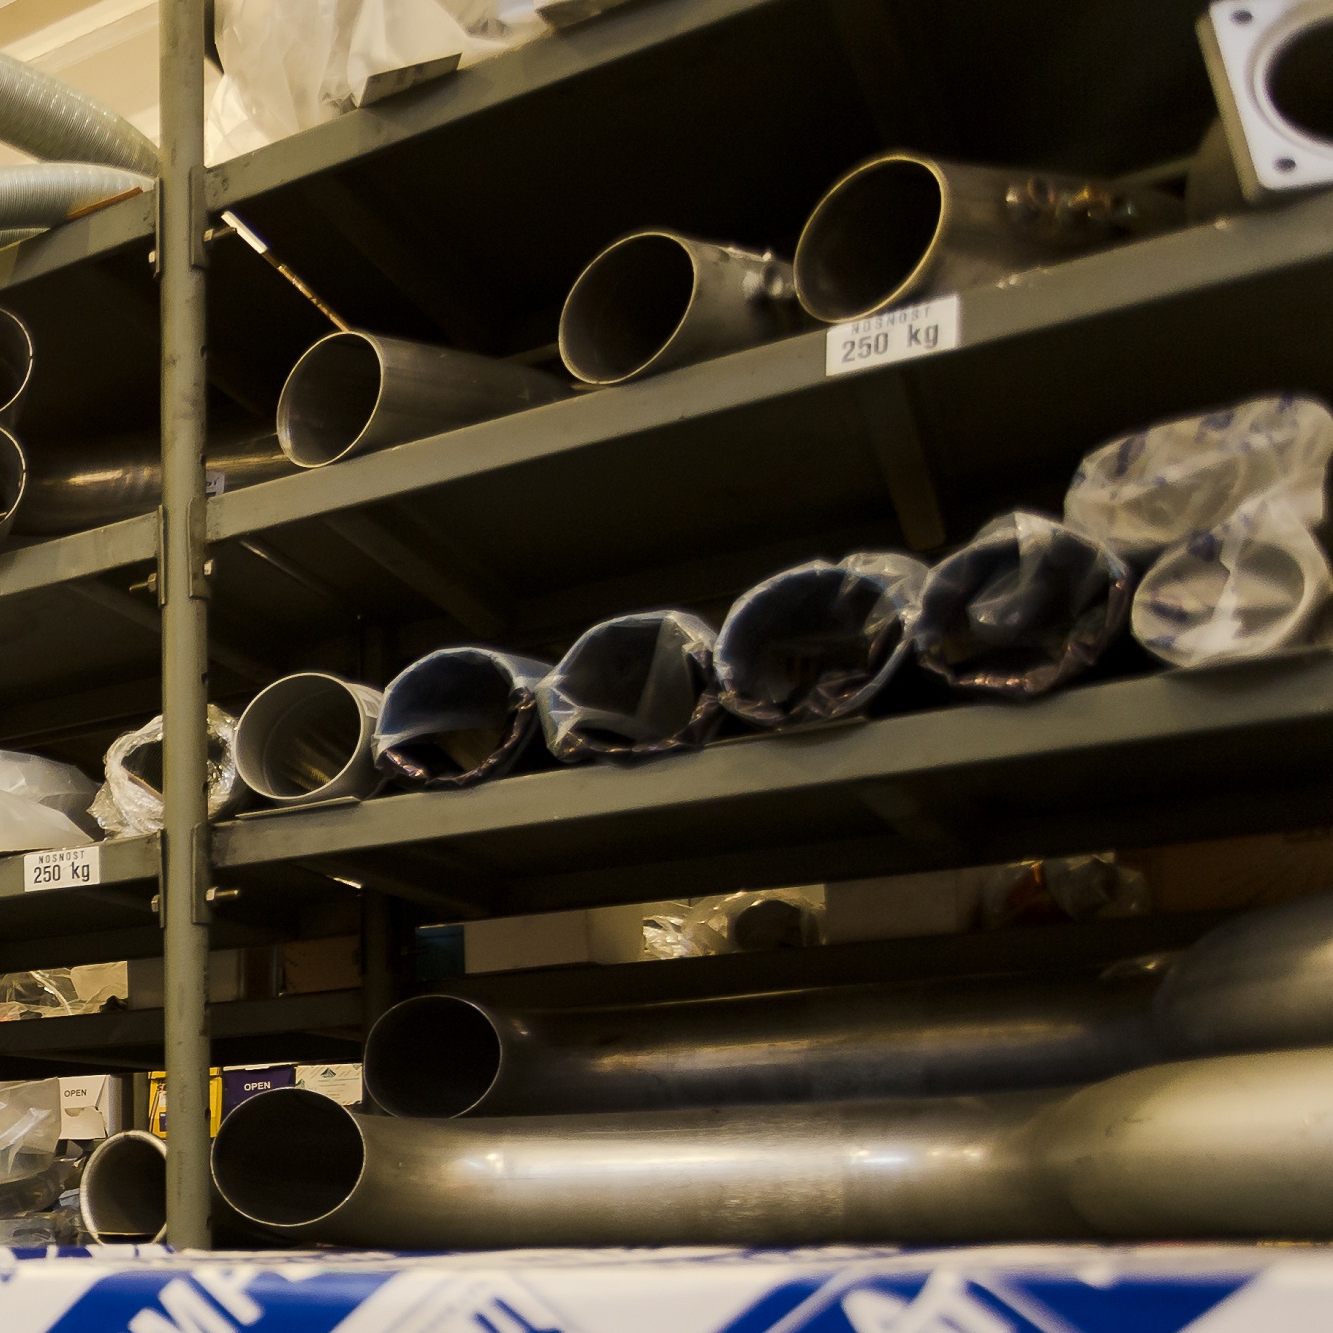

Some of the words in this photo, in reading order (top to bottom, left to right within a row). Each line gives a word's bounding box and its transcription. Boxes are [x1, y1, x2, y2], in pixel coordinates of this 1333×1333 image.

[850, 306, 932, 335] NOSNOST
[841, 333, 889, 363] 250
[907, 323, 939, 350] kg
[39, 850, 86, 864] NOSNOST
[34, 865, 62, 884] 250
[72, 862, 90, 882] kg
[64, 1089, 87, 1098] OPEN
[244, 1082, 271, 1091] OPEN
